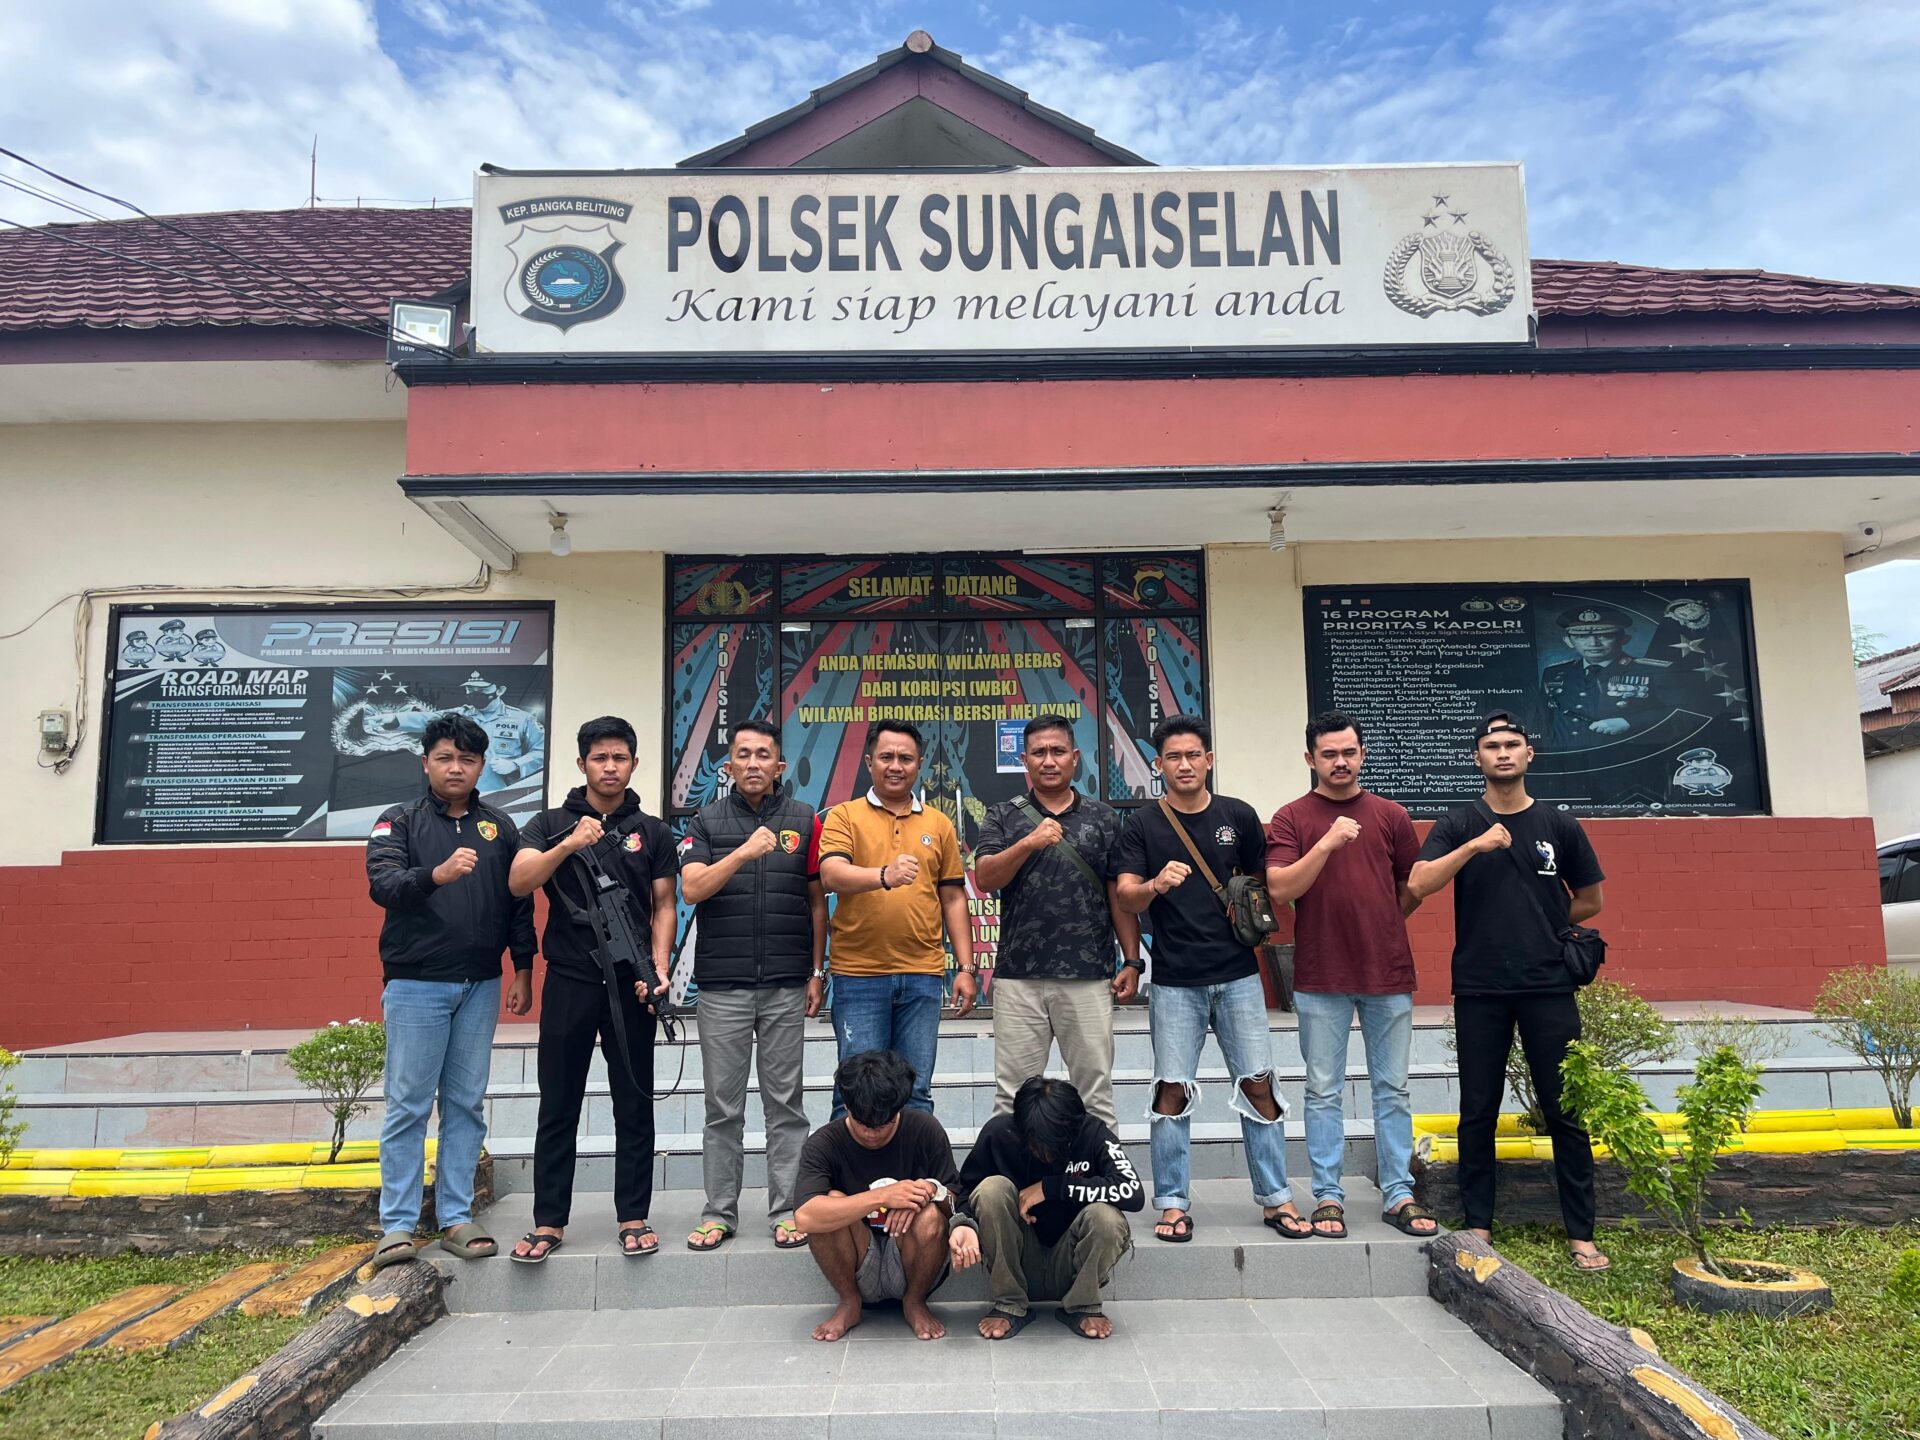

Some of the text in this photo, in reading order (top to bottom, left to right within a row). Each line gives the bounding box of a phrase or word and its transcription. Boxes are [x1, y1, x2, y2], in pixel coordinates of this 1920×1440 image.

[506, 201, 625, 219] KEP. BANGKA BELITUNG
[667, 189, 1342, 273] POLSEK SUNGAISELAN
[664, 276, 1345, 334] Kami siap melayani anda
[848, 575, 1017, 597] SELAMAT DATANG
[1321, 610, 1449, 619] 16 PROGRAM
[261, 619, 521, 647] PRESISI
[1323, 620, 1521, 630] PRIORITAS KAPOLRI
[1465, 649, 1501, 657] Unggul
[1479, 642, 1530, 650] Organisasi
[818, 652, 1062, 671] ANDA MEMASUKI WILAYAH BEBAS
[161, 669, 309, 685] ROAD MAP
[161, 683, 307, 697] TRANSFORMASI POLRI
[717, 632, 729, 745] POLSEK
[861, 679, 1017, 697] DARI KORUPSI (WBK)
[798, 705, 864, 722] WILAYAH
[867, 704, 951, 721] BIROKRASI
[952, 704, 1009, 720] BERSIH
